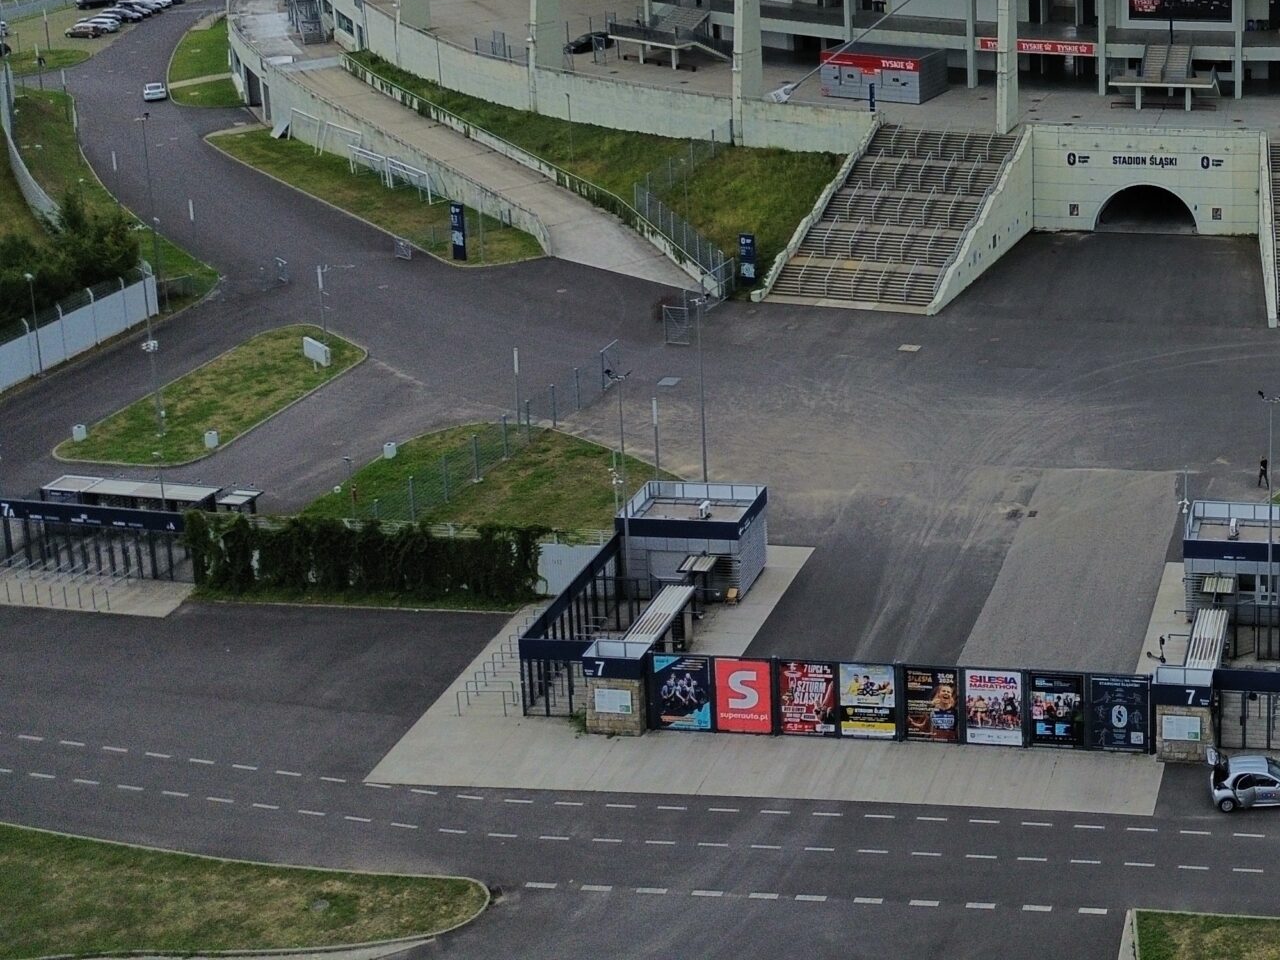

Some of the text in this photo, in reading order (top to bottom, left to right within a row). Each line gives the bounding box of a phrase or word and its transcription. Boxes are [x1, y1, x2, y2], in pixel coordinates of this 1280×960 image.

[1022, 43, 1043, 51] TYSKIE
[1057, 45, 1078, 53] TYSKIE
[881, 60, 905, 69] TYSKIE
[1112, 155, 1177, 168] STADION ŚLĄSKI
[595, 661, 605, 676] 7
[969, 674, 1017, 685] SILESIA
[728, 670, 759, 709] S
[796, 681, 826, 693] SZTURM
[1185, 689, 1196, 705] 7
[720, 712, 768, 721] superauto.pl
